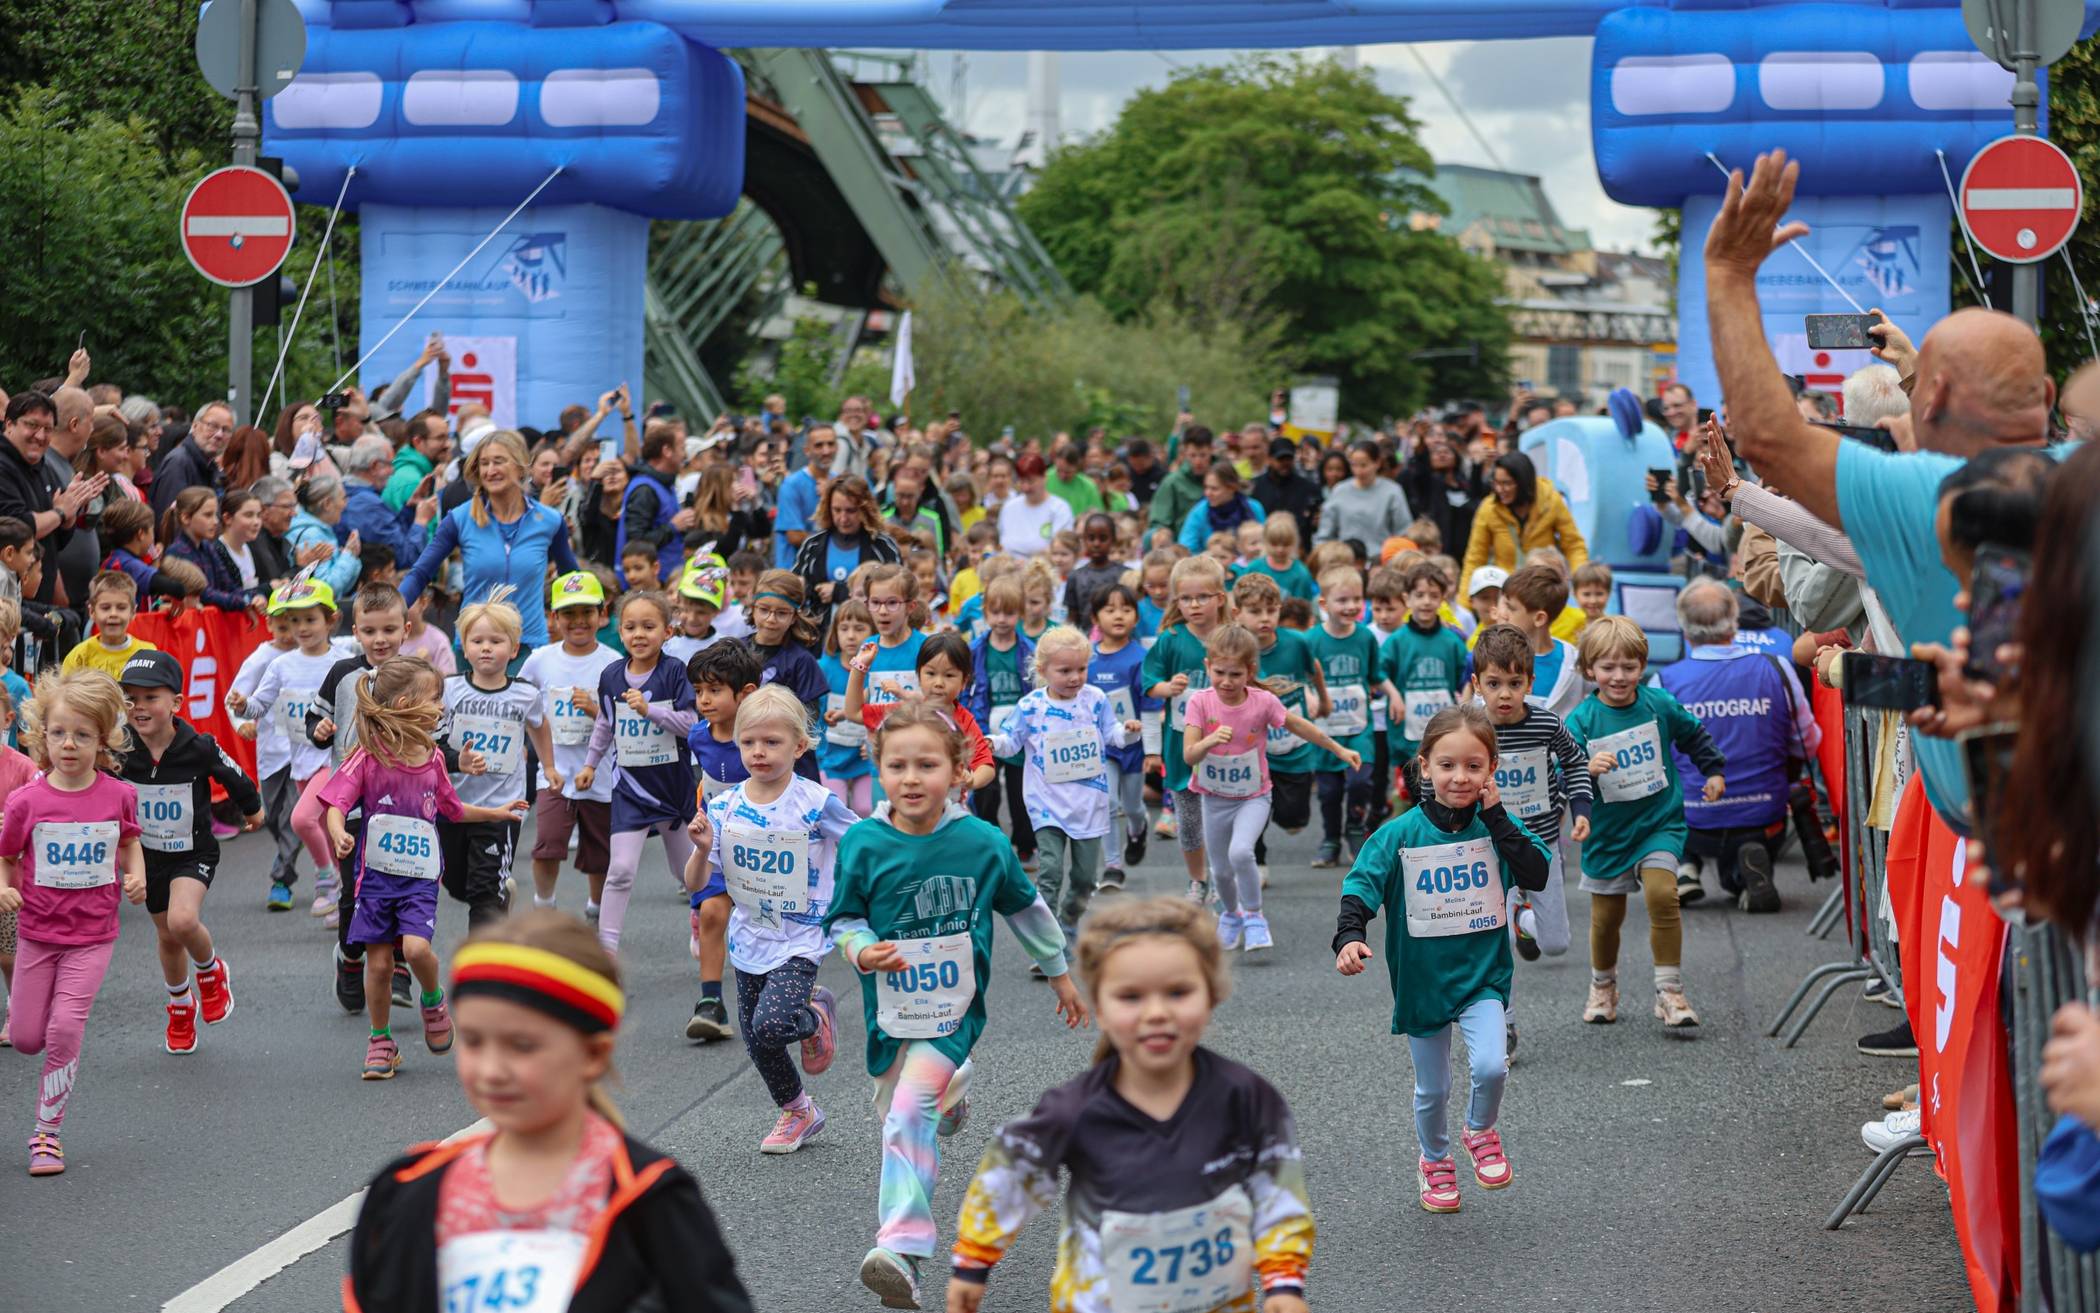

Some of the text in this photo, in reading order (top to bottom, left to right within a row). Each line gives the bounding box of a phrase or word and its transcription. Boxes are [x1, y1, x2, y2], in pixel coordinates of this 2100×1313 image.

[1684, 697, 1771, 719] FOTOGRAF
[649, 754, 671, 764] 7873
[1050, 741, 1098, 764] 10352
[1610, 740, 1656, 771] 035
[1206, 764, 1251, 783] 6184
[1494, 766, 1537, 788] 994
[137, 800, 182, 821] 100
[1520, 802, 1542, 816] 1994
[46, 841, 107, 866] 8446
[162, 840, 184, 850] 1100
[378, 831, 431, 858] 4355
[733, 844, 795, 875] 8520
[1416, 861, 1489, 895] 4056
[742, 883, 784, 897] Bambini-Lauf
[1431, 907, 1483, 920] Bambini-Lauf
[1469, 914, 1498, 930] 4056
[895, 927, 931, 940] Team
[932, 917, 969, 936] Junio
[886, 960, 960, 993] 4050
[897, 1009, 952, 1020] Bambini-Lauf
[936, 1018, 961, 1034] 405
[1130, 1225, 1236, 1286] 2738
